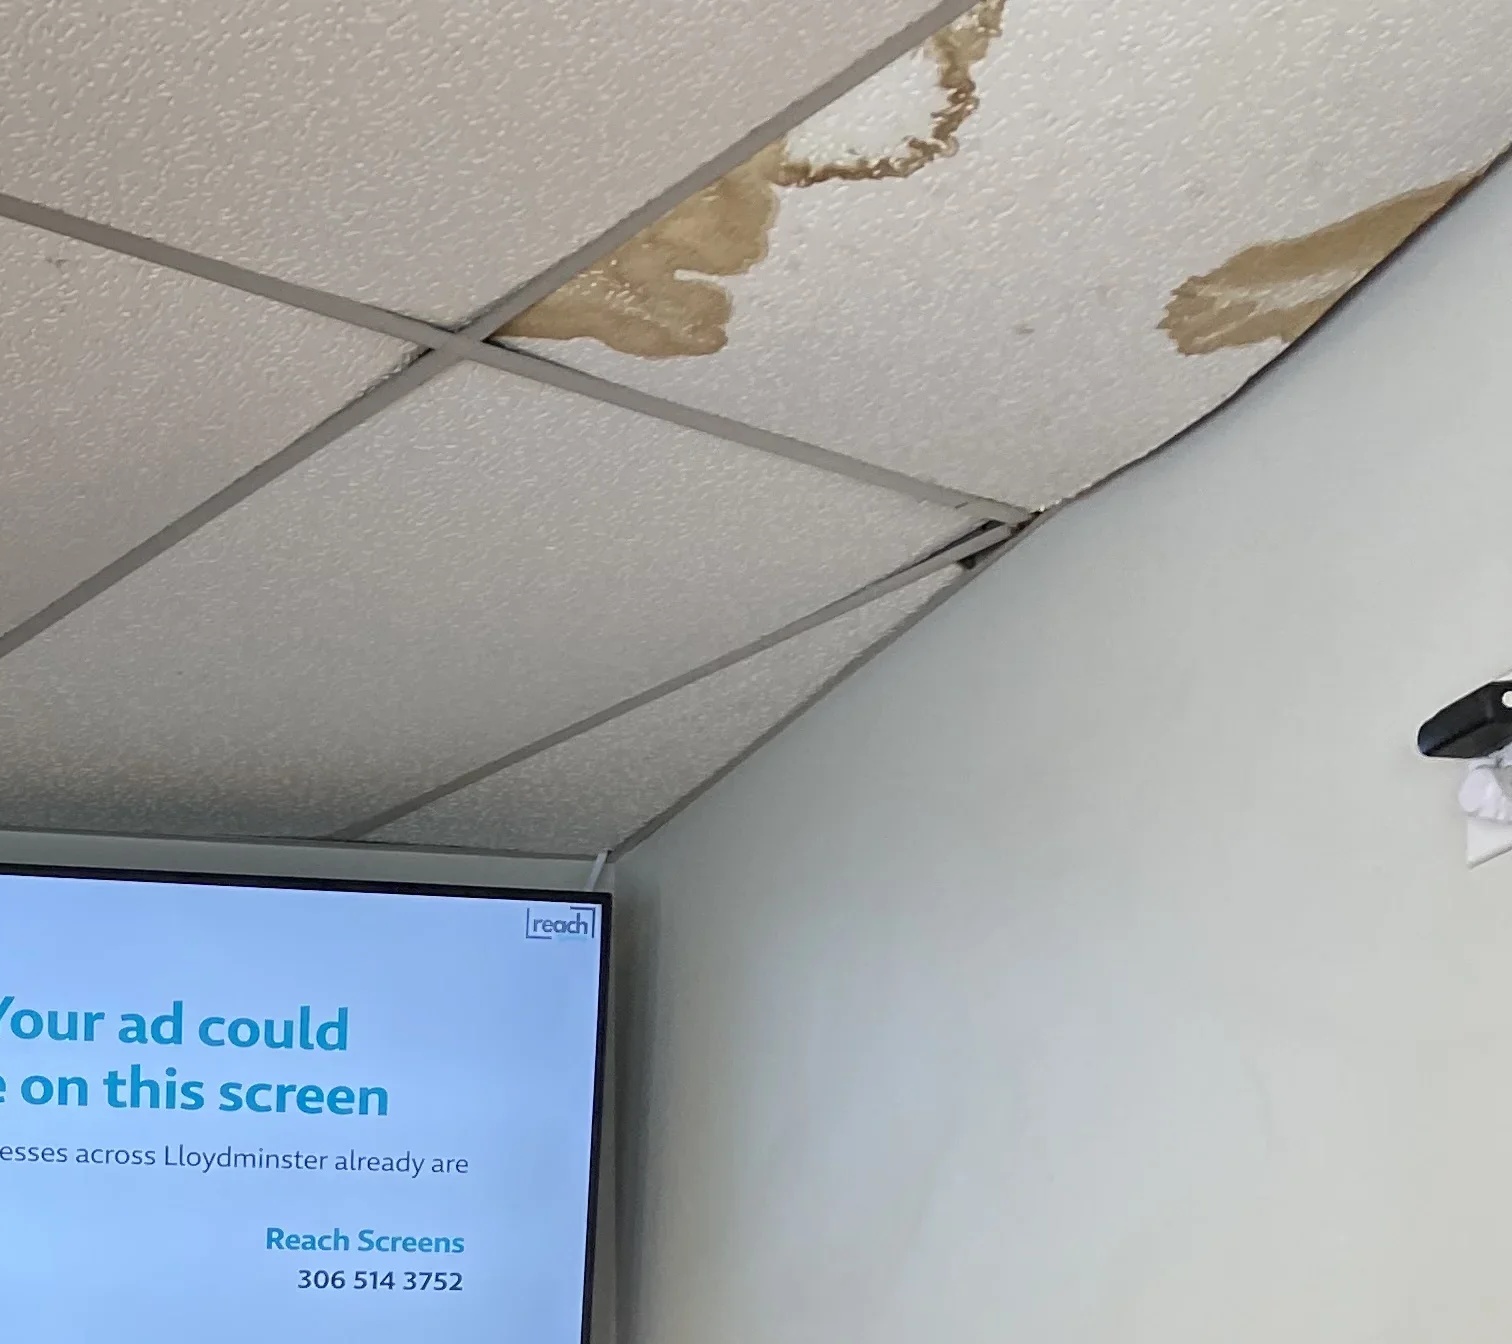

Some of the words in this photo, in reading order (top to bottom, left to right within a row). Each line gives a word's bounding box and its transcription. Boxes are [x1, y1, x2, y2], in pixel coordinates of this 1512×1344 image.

[532, 911, 589, 935] reach
[119, 1000, 185, 1045] ad
[199, 1006, 350, 1052] could
[21, 1074, 90, 1107] on
[103, 1064, 206, 1111] this
[219, 1081, 390, 1117] screen
[76, 1148, 157, 1166] across
[164, 1144, 329, 1174] Lloydminster
[335, 1149, 426, 1179] already
[432, 1158, 470, 1174] are
[266, 1227, 351, 1252] Reach
[358, 1229, 466, 1254] Screens
[298, 1269, 347, 1290] 306
[353, 1270, 397, 1291] 514
[403, 1271, 464, 1292] 3752
